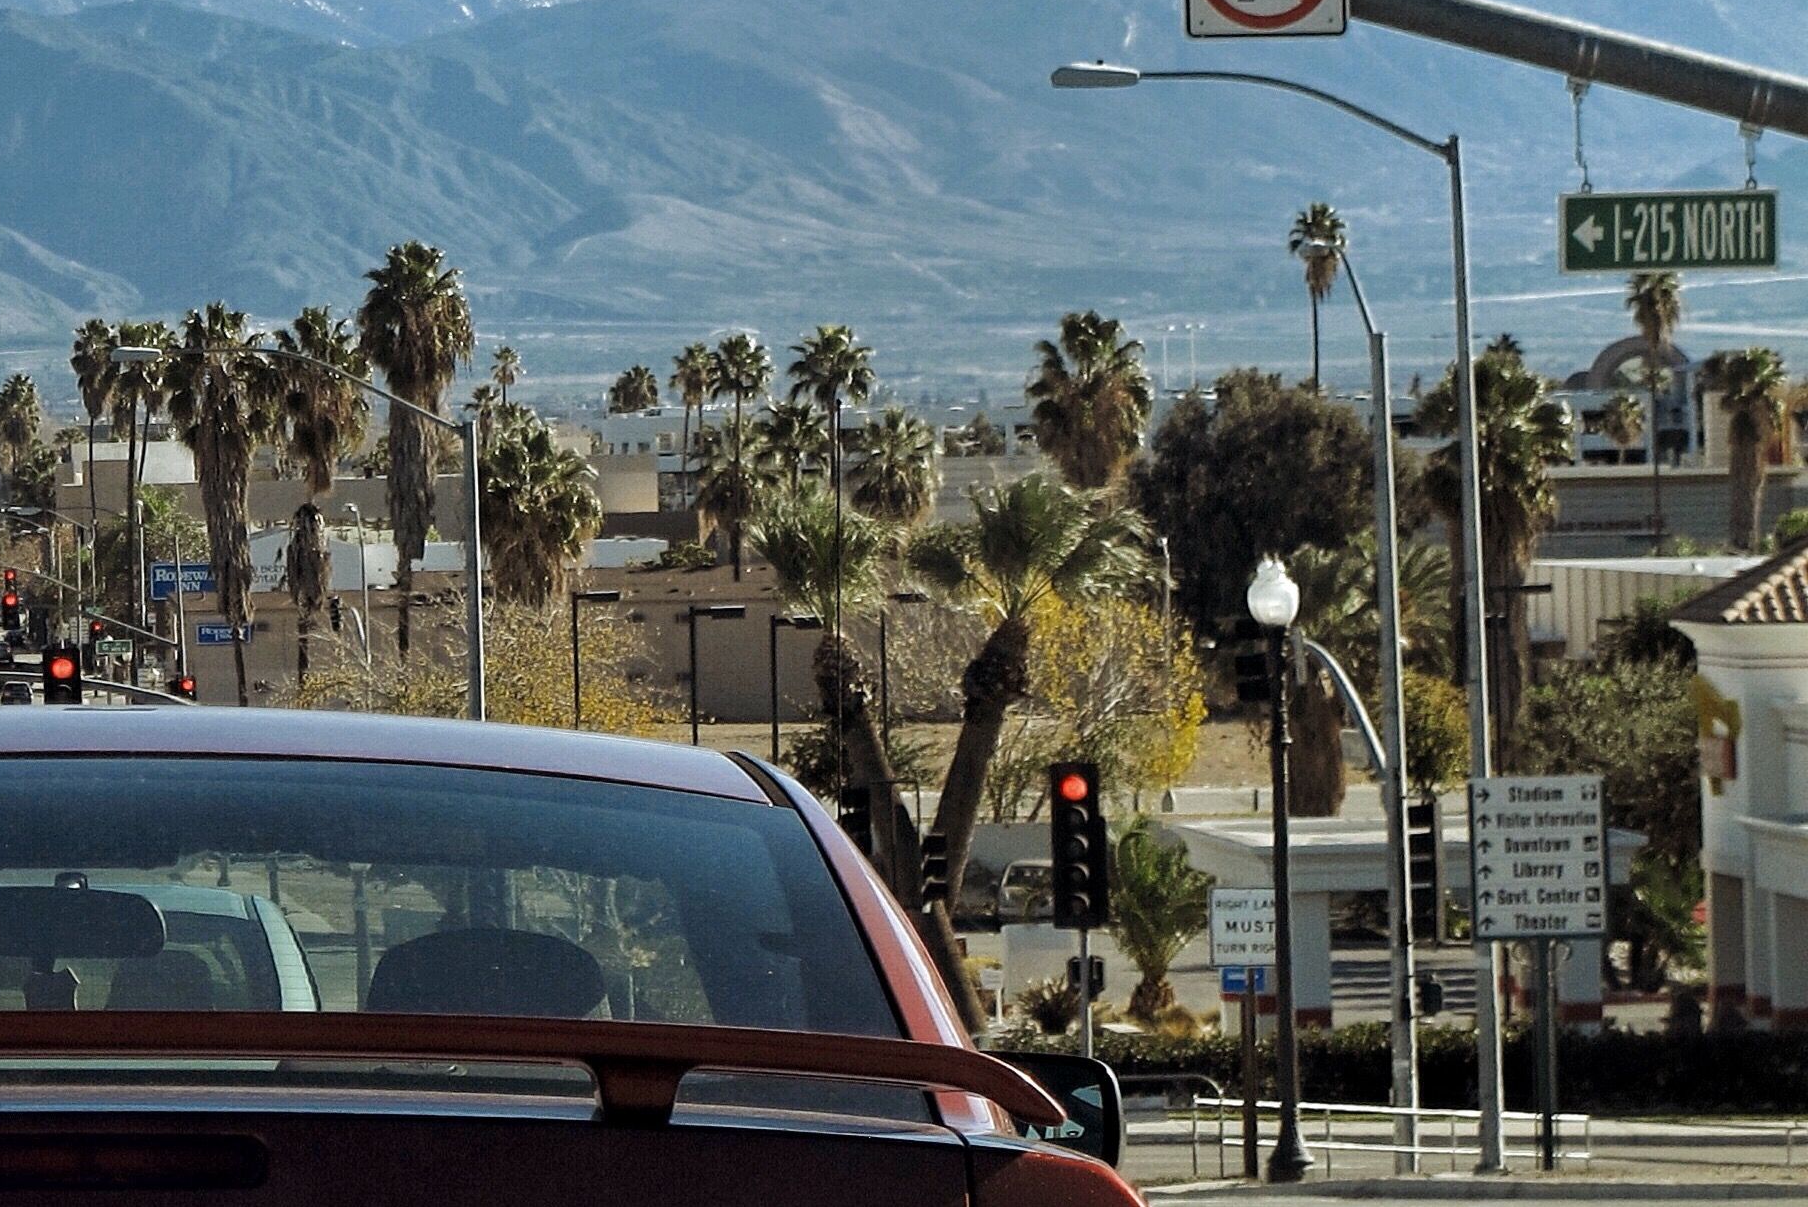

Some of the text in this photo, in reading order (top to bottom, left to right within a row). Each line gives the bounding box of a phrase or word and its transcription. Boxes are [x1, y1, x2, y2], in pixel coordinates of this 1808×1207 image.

[1614, 201, 1766, 262] I-215 NORTH
[1508, 786, 1563, 803] Stadium
[1505, 837, 1570, 853] Downtown
[1513, 862, 1563, 879] Library
[1536, 888, 1580, 905] Center
[1224, 921, 1275, 933] MUST
[1515, 913, 1568, 930] Theater
[1216, 943, 1247, 954] TURN
